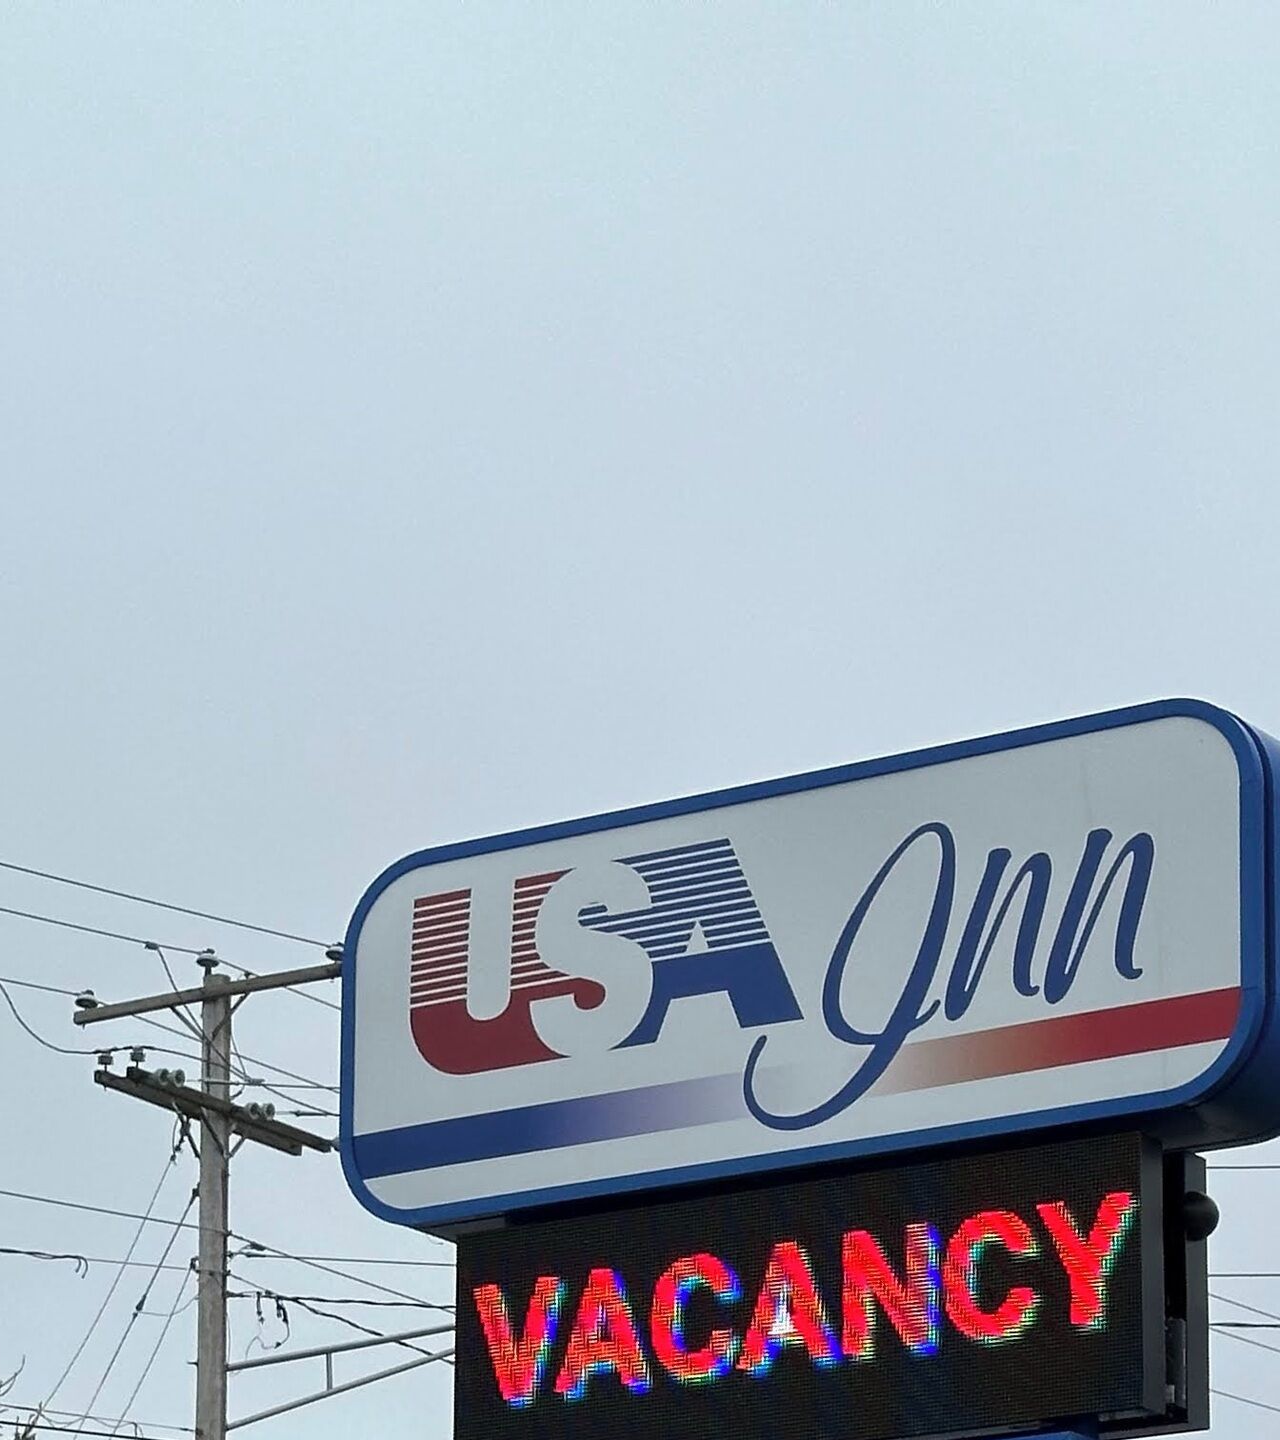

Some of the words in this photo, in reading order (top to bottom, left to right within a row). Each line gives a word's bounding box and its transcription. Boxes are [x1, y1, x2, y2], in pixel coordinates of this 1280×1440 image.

[409, 838, 804, 1075] USA
[743, 821, 1155, 1131] Inn
[472, 1191, 1136, 1408] VACANCY
